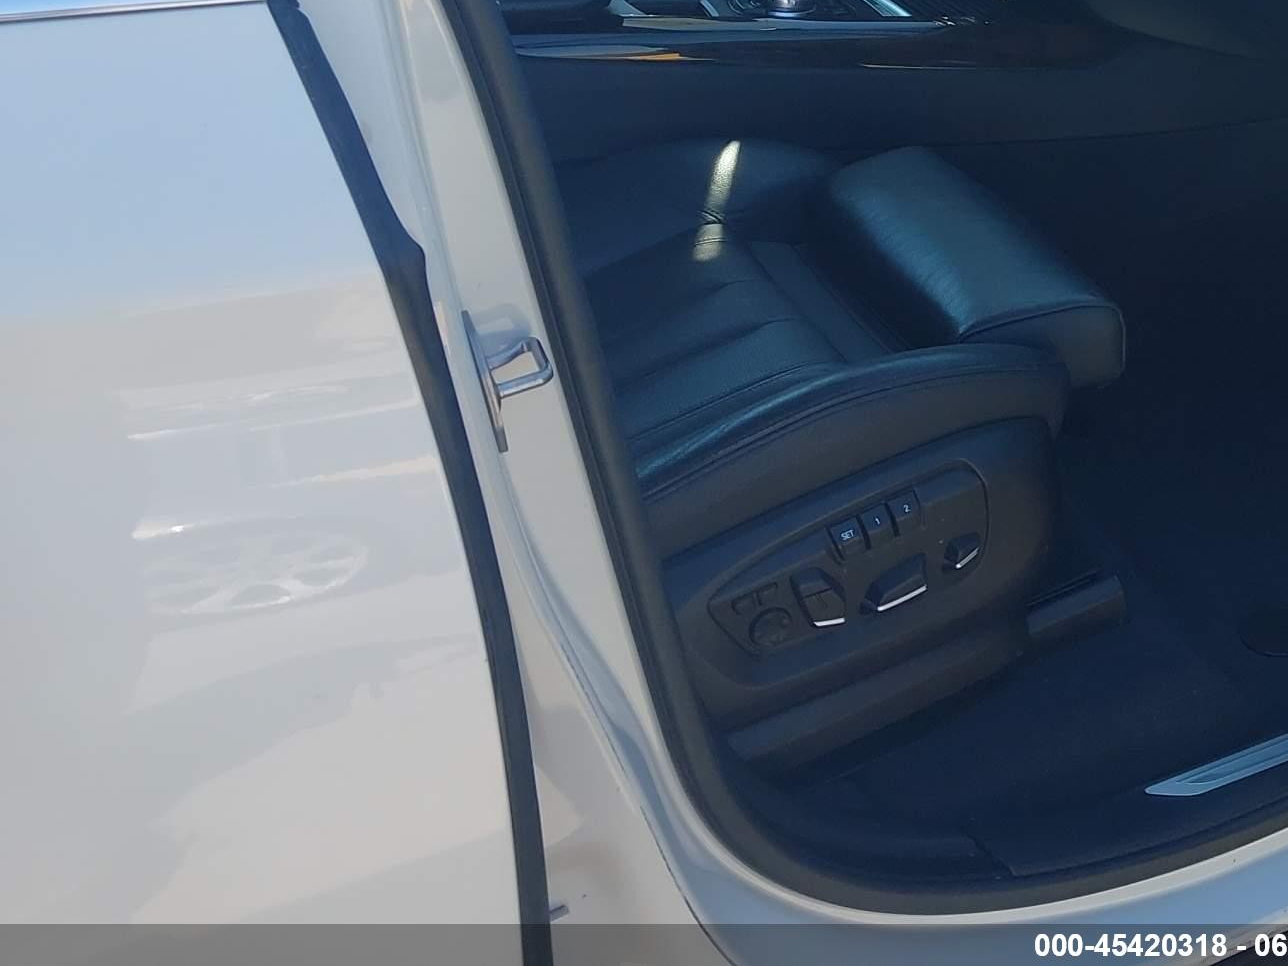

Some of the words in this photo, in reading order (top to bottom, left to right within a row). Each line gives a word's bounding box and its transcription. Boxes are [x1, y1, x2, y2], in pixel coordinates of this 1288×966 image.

[903, 504, 911, 513] 2
[875, 517, 881, 525] 1
[840, 529, 854, 541] SET
